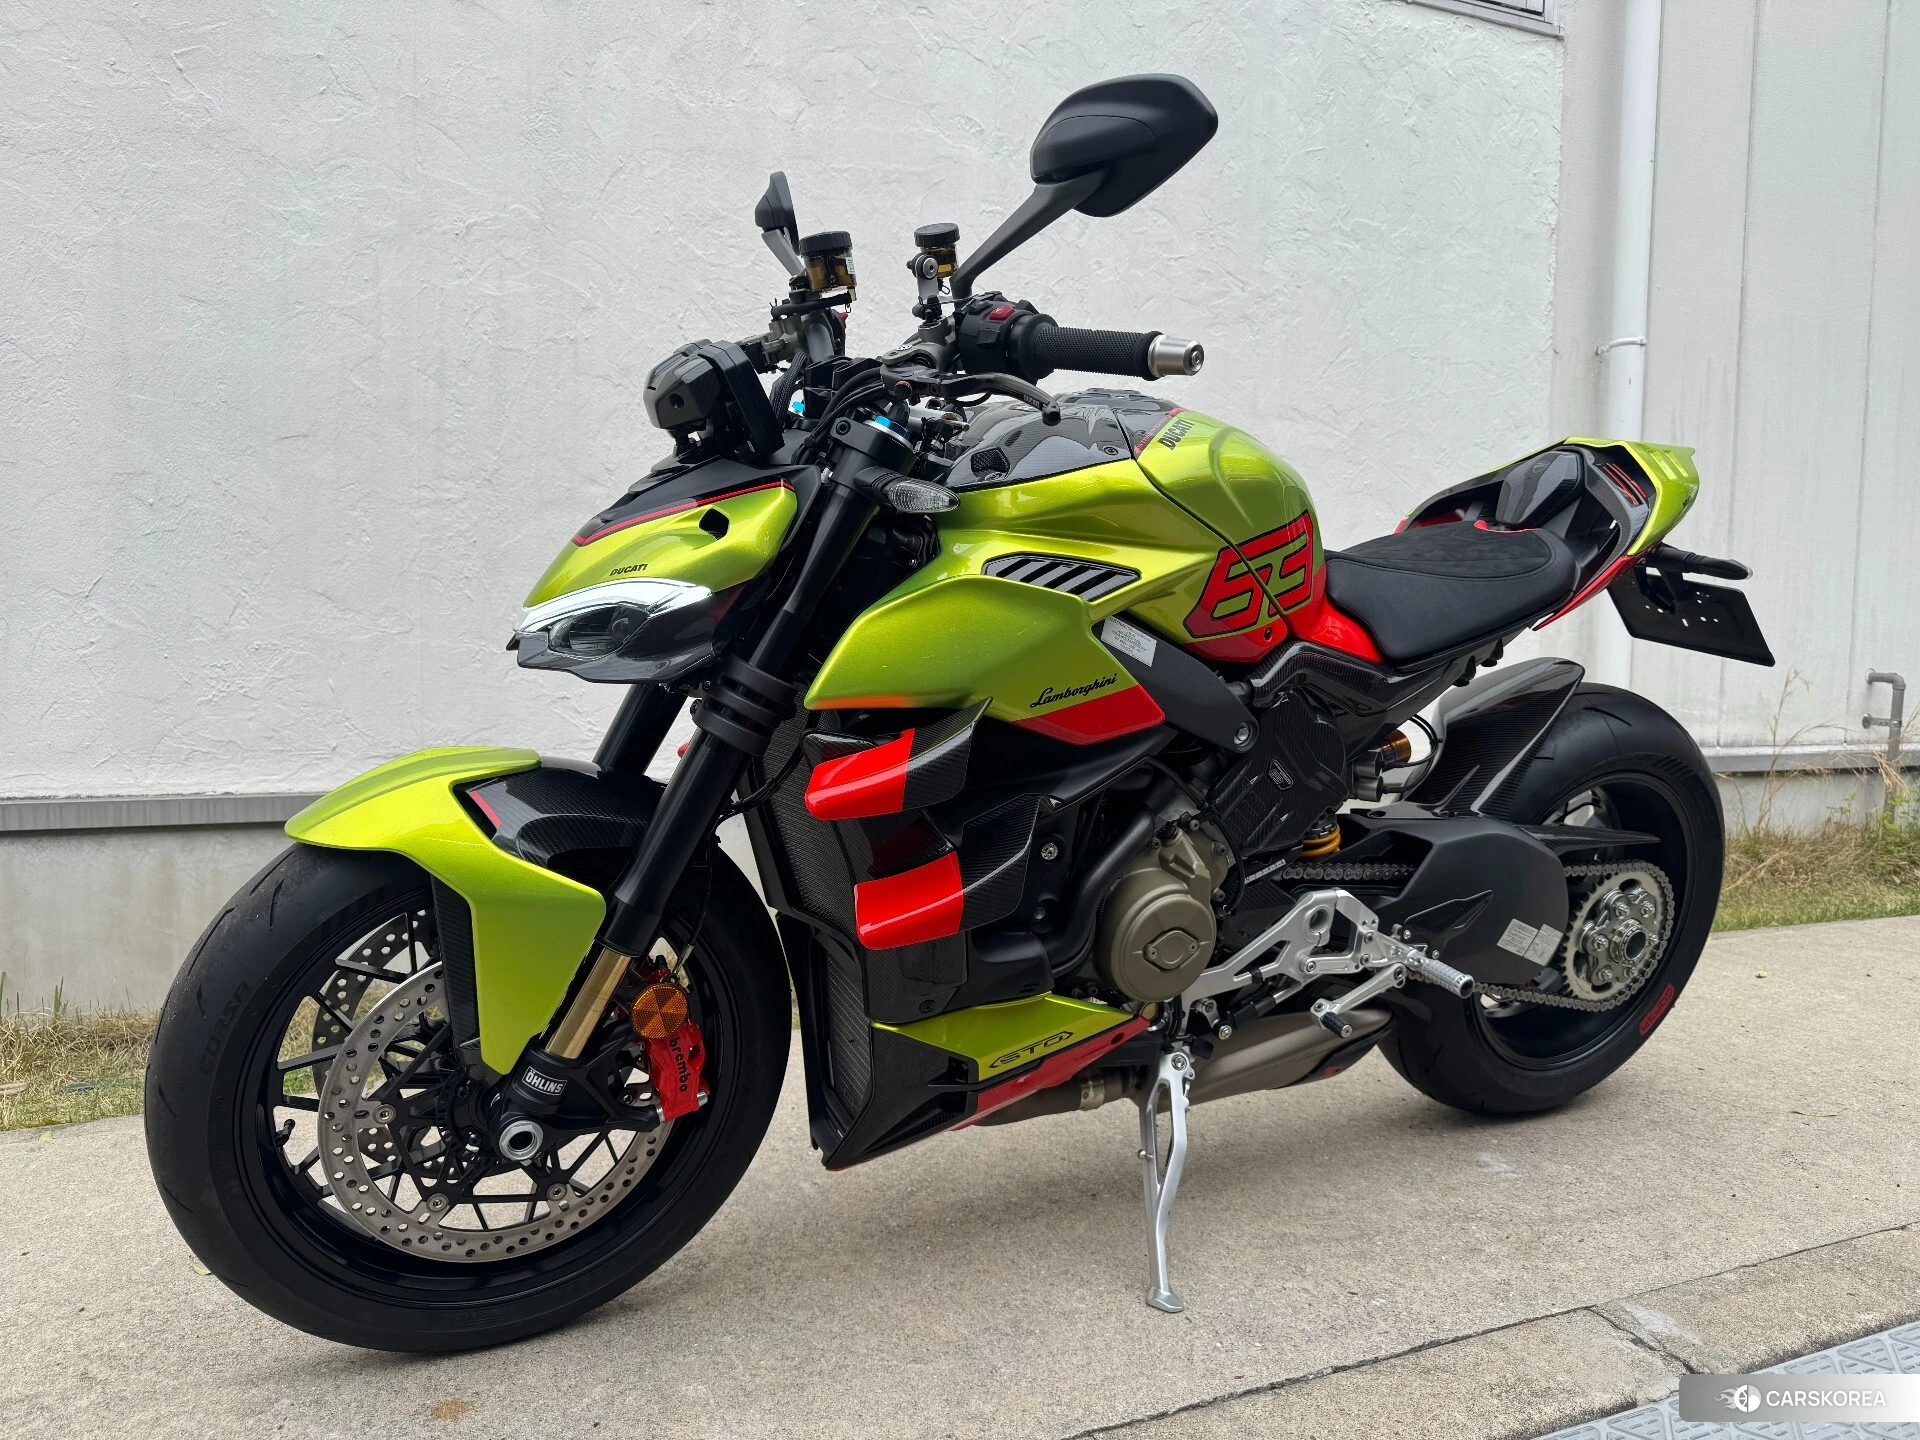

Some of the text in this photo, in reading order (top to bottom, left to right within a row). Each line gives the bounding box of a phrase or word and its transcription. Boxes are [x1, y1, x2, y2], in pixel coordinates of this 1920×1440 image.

[1157, 418, 1195, 451] DUCATI
[609, 563, 649, 577] DUCATI
[1183, 509, 1313, 639] 63
[1029, 672, 1118, 708] Lamborghini
[201, 979, 250, 1075] CORSA
[1641, 987, 1675, 1031] CORSA
[668, 1036, 692, 1092] brembo
[1000, 1034, 1064, 1064] STO
[525, 1069, 564, 1093] ÖHLINS
